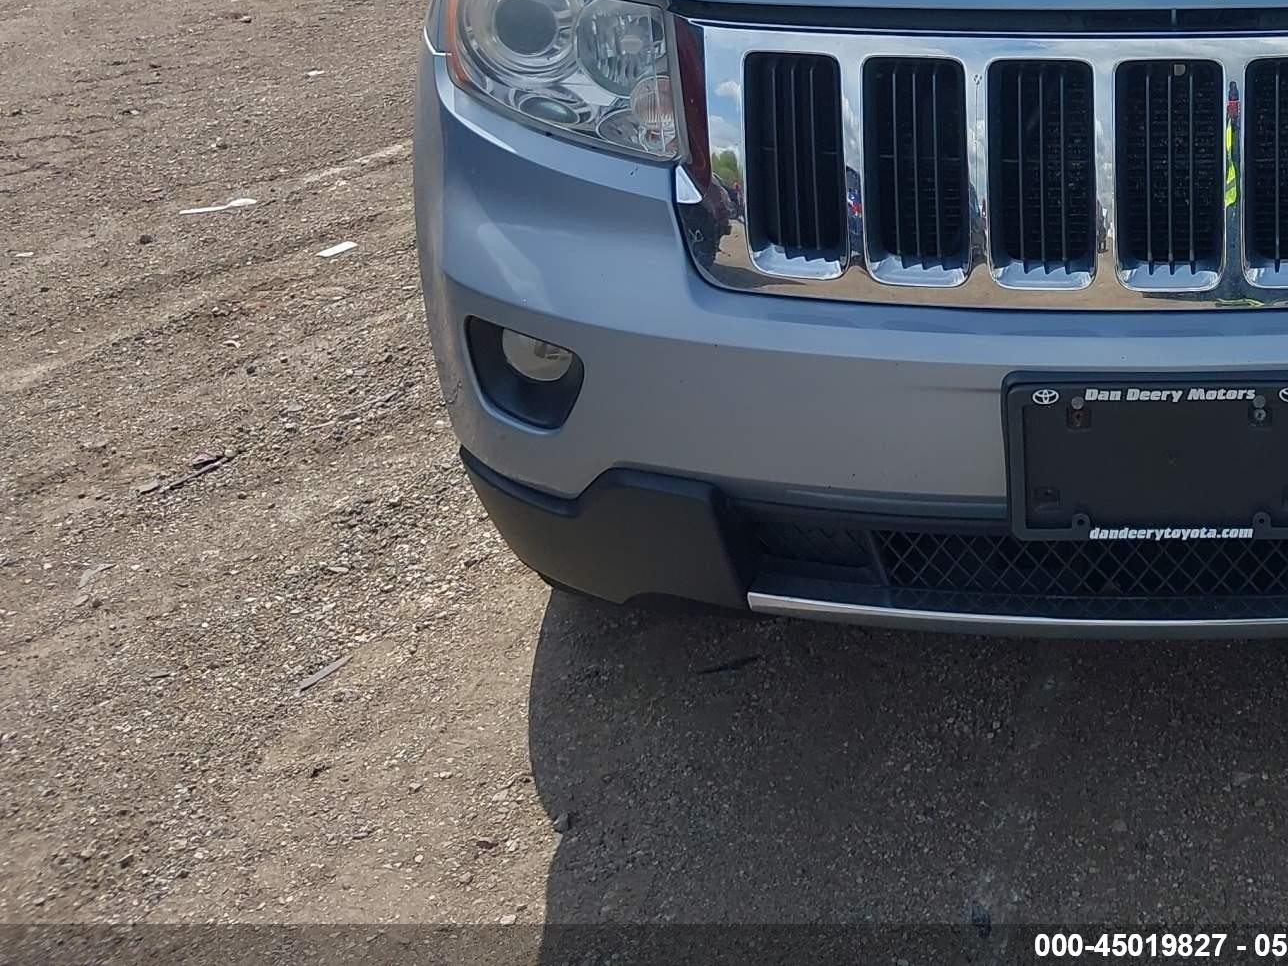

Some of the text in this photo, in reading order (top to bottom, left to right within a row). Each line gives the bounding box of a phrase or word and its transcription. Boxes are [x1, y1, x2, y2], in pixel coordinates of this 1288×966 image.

[1085, 388, 1256, 402] Dan Deery Motors
[1090, 528, 1253, 540] dandeerytoyota.com
